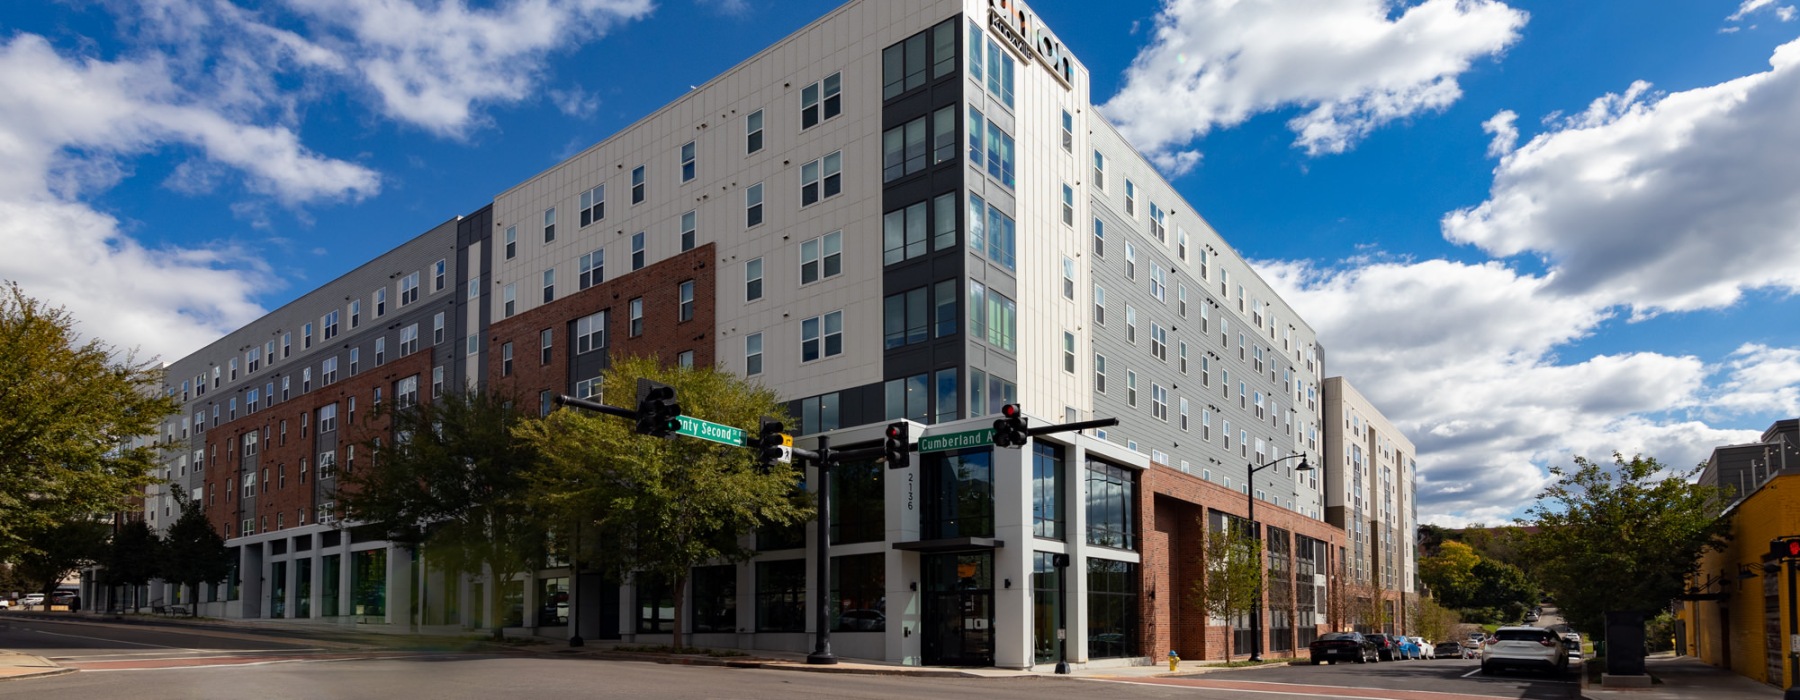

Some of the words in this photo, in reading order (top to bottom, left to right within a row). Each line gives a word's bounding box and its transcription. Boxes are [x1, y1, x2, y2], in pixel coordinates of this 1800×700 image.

[678, 419, 699, 436] nty
[701, 421, 731, 440] Second
[921, 434, 981, 450] Cumberland
[986, 430, 996, 443] A
